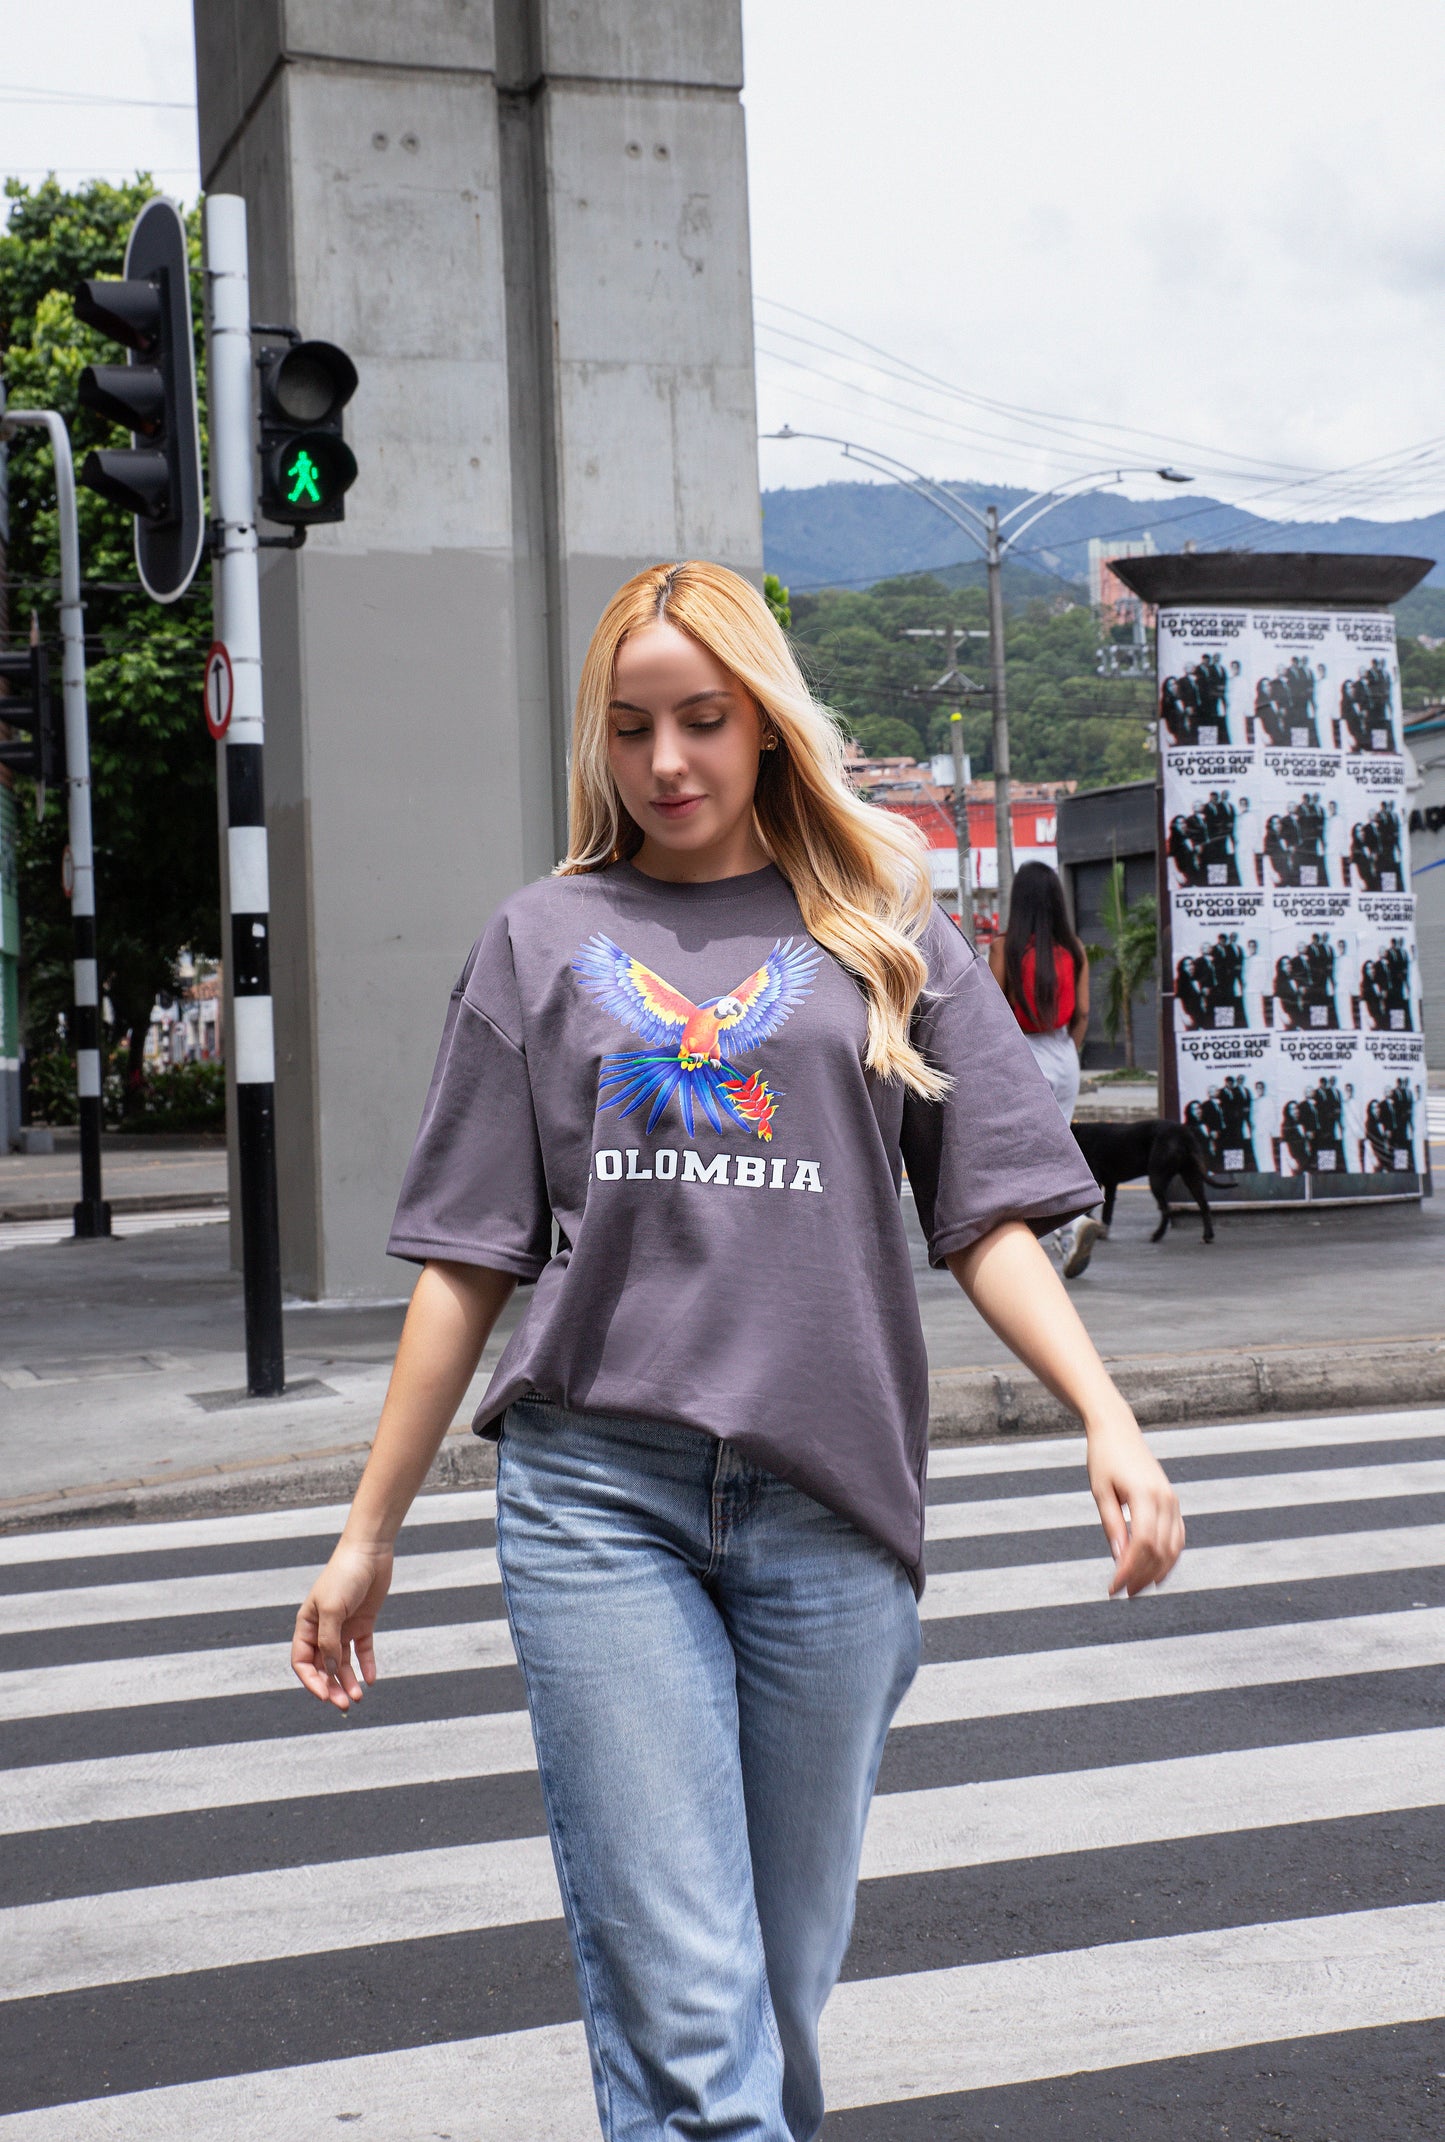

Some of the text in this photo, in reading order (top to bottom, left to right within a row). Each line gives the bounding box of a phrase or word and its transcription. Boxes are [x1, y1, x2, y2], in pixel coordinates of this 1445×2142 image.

[1161, 619, 1246, 628] LO POCO QUE
[1253, 621, 1330, 631] LO POCO QUE
[1170, 629, 1239, 637] YO QUIERO
[1263, 631, 1277, 640] YO
[1167, 758, 1184, 767] LO
[1188, 756, 1225, 765] POCO
[1229, 755, 1254, 764] QUE
[1265, 759, 1280, 767] LO
[1284, 758, 1316, 767] POCO
[1319, 759, 1341, 768] QUE
[1177, 766, 1247, 776] YO QUIERO
[1274, 768, 1289, 776] YO
[1176, 898, 1264, 908] LO POCO QUE
[1273, 899, 1289, 907] LO
[1292, 899, 1325, 907] POCO
[1328, 898, 1350, 907] QUE
[1185, 907, 1256, 917] YO QUIERO
[1283, 908, 1298, 917] YO
[1182, 1039, 1271, 1051] LO POCO QUE
[1281, 1041, 1358, 1052] LO POCO QUE
[1192, 1049, 1263, 1061] YO QUIERO
[1290, 1052, 1305, 1061] YO
[588, 1148, 824, 1193] OLOMBIA
